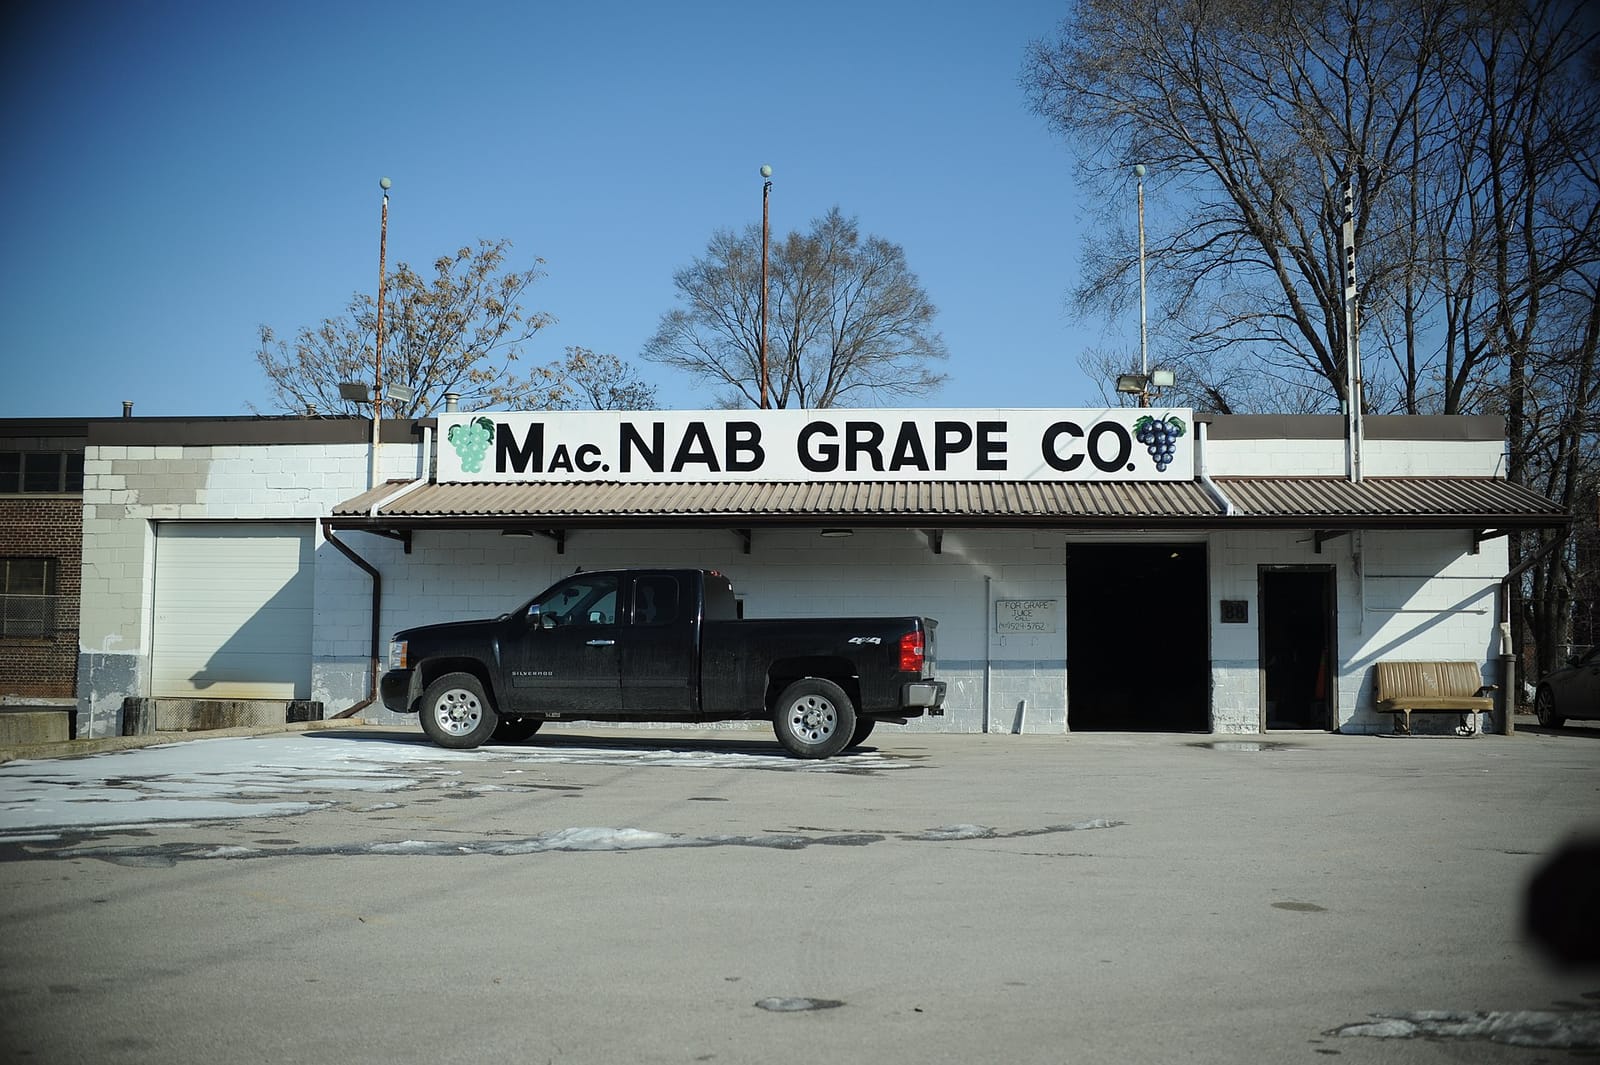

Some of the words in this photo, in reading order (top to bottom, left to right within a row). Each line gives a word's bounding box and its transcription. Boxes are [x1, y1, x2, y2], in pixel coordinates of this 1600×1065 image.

[619, 421, 766, 473] NAB
[796, 420, 1008, 473] GRAPE
[1041, 420, 1137, 474] CO.
